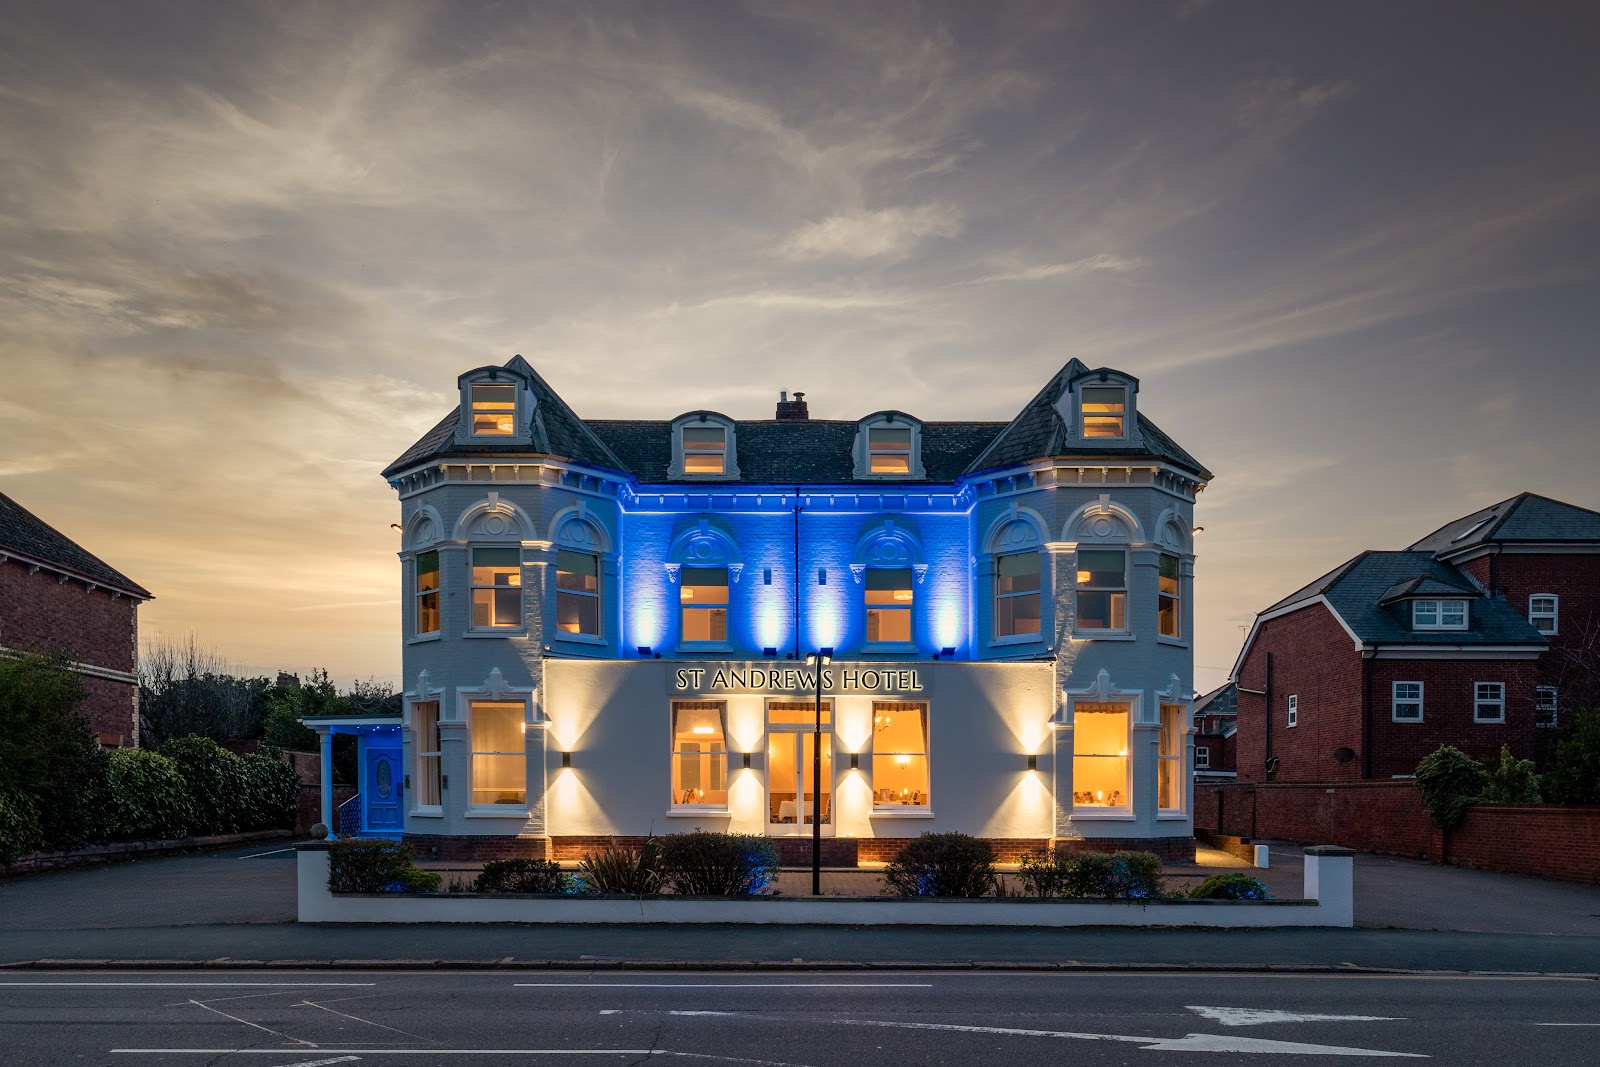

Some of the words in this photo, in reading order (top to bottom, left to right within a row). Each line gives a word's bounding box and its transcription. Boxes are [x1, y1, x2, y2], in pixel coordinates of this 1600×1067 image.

[677, 669, 704, 689] ST
[711, 669, 833, 690] ANDREWS
[843, 670, 922, 690] HOTEL
